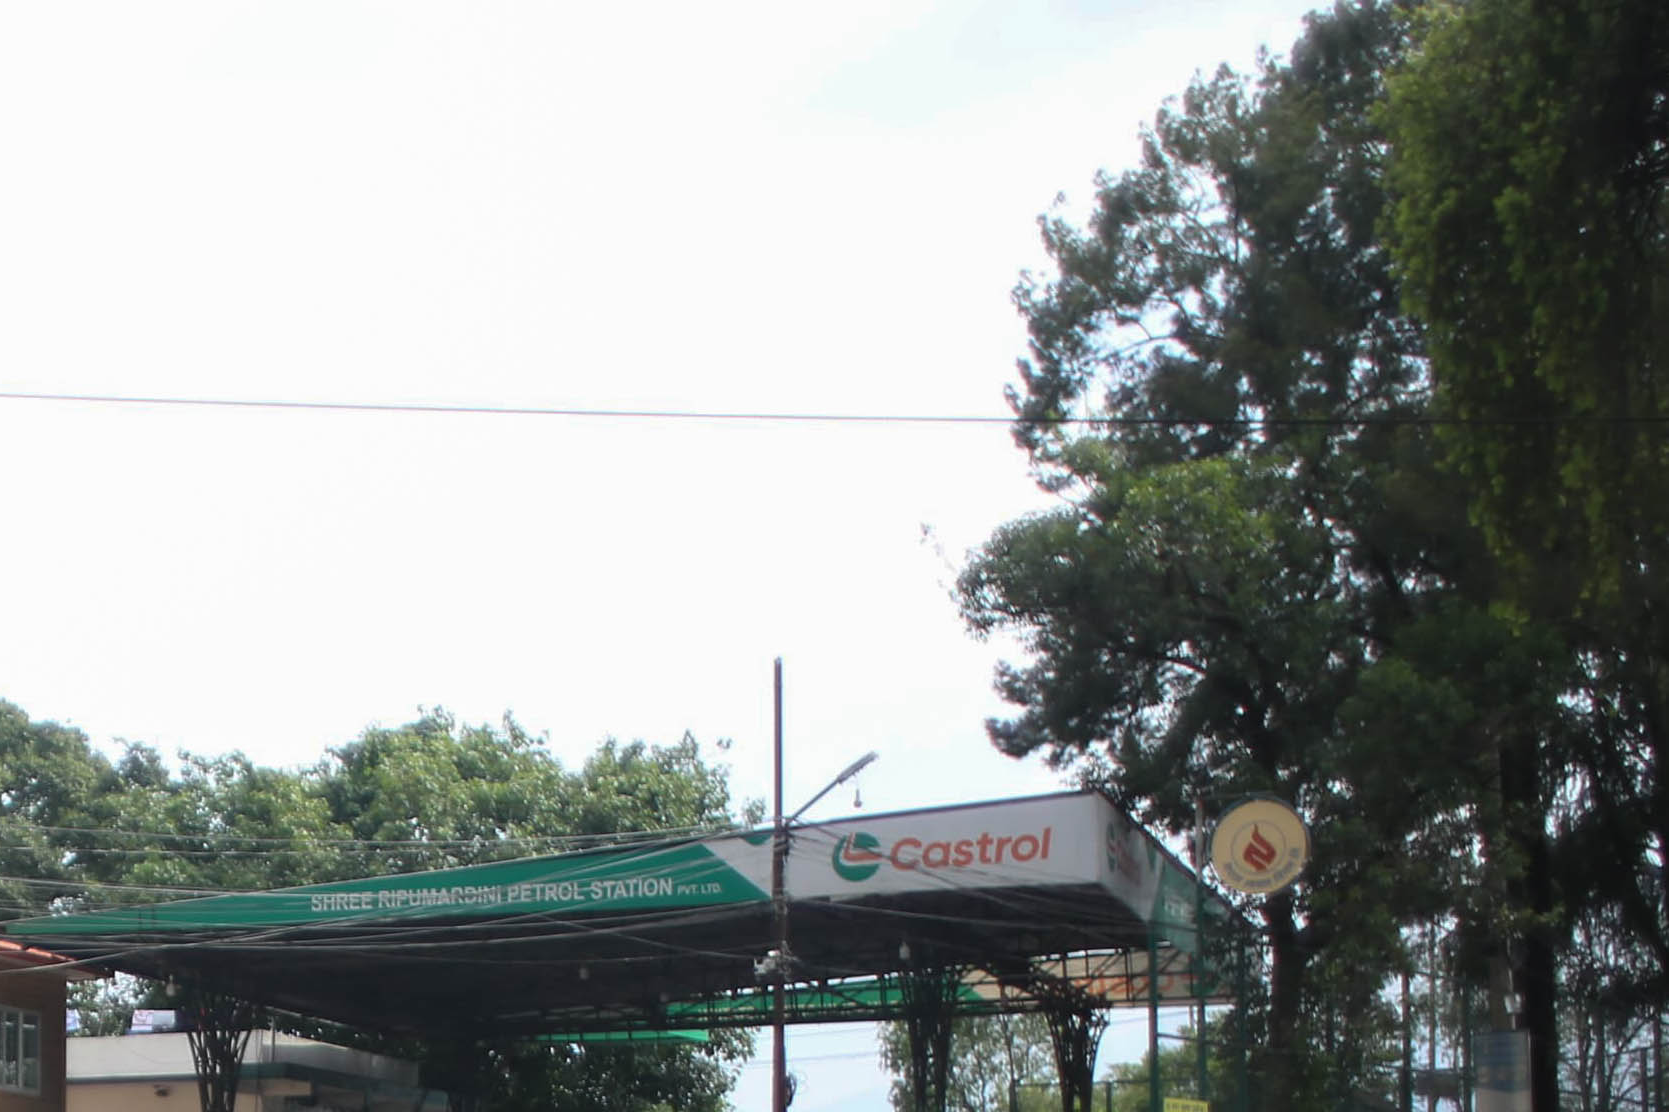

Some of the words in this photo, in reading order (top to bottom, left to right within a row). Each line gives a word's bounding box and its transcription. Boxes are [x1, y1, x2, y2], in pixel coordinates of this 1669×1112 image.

[891, 827, 1051, 870] Castrol
[311, 890, 373, 912] SHREE
[378, 884, 503, 909] RIPUMARDINI
[508, 880, 581, 904] PETROL
[590, 877, 673, 900] STATION
